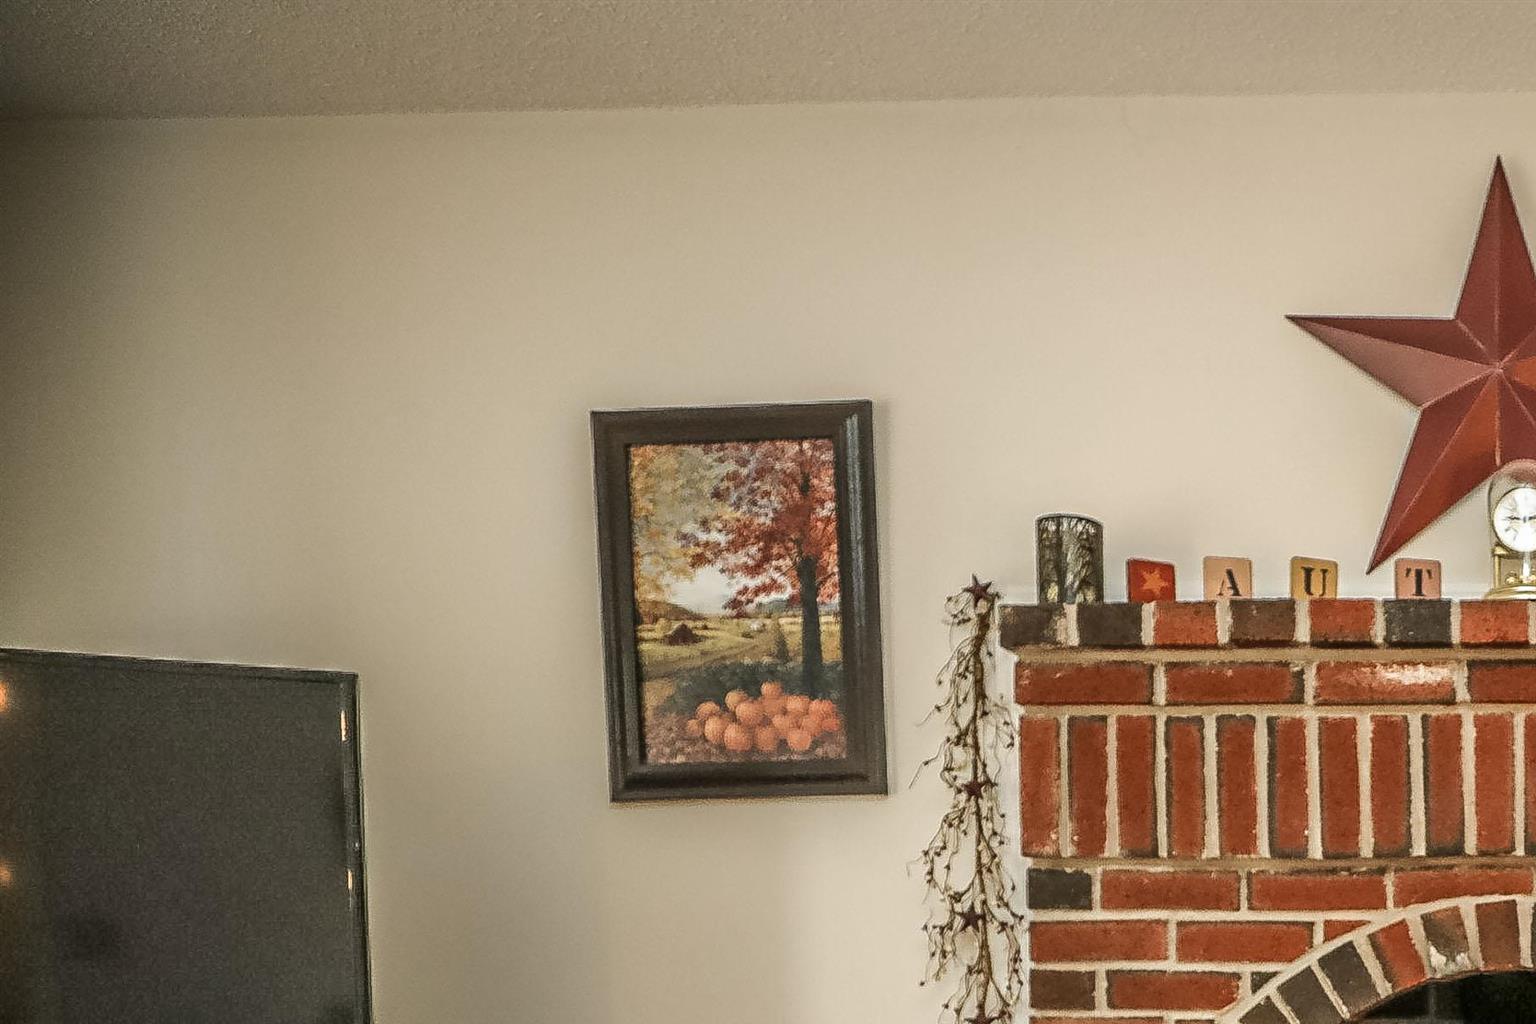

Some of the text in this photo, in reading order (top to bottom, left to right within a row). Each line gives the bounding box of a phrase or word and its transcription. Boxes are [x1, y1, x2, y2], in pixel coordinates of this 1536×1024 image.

[1216, 568, 1242, 596] A
[1301, 566, 1331, 596] U
[1405, 567, 1433, 597] T
